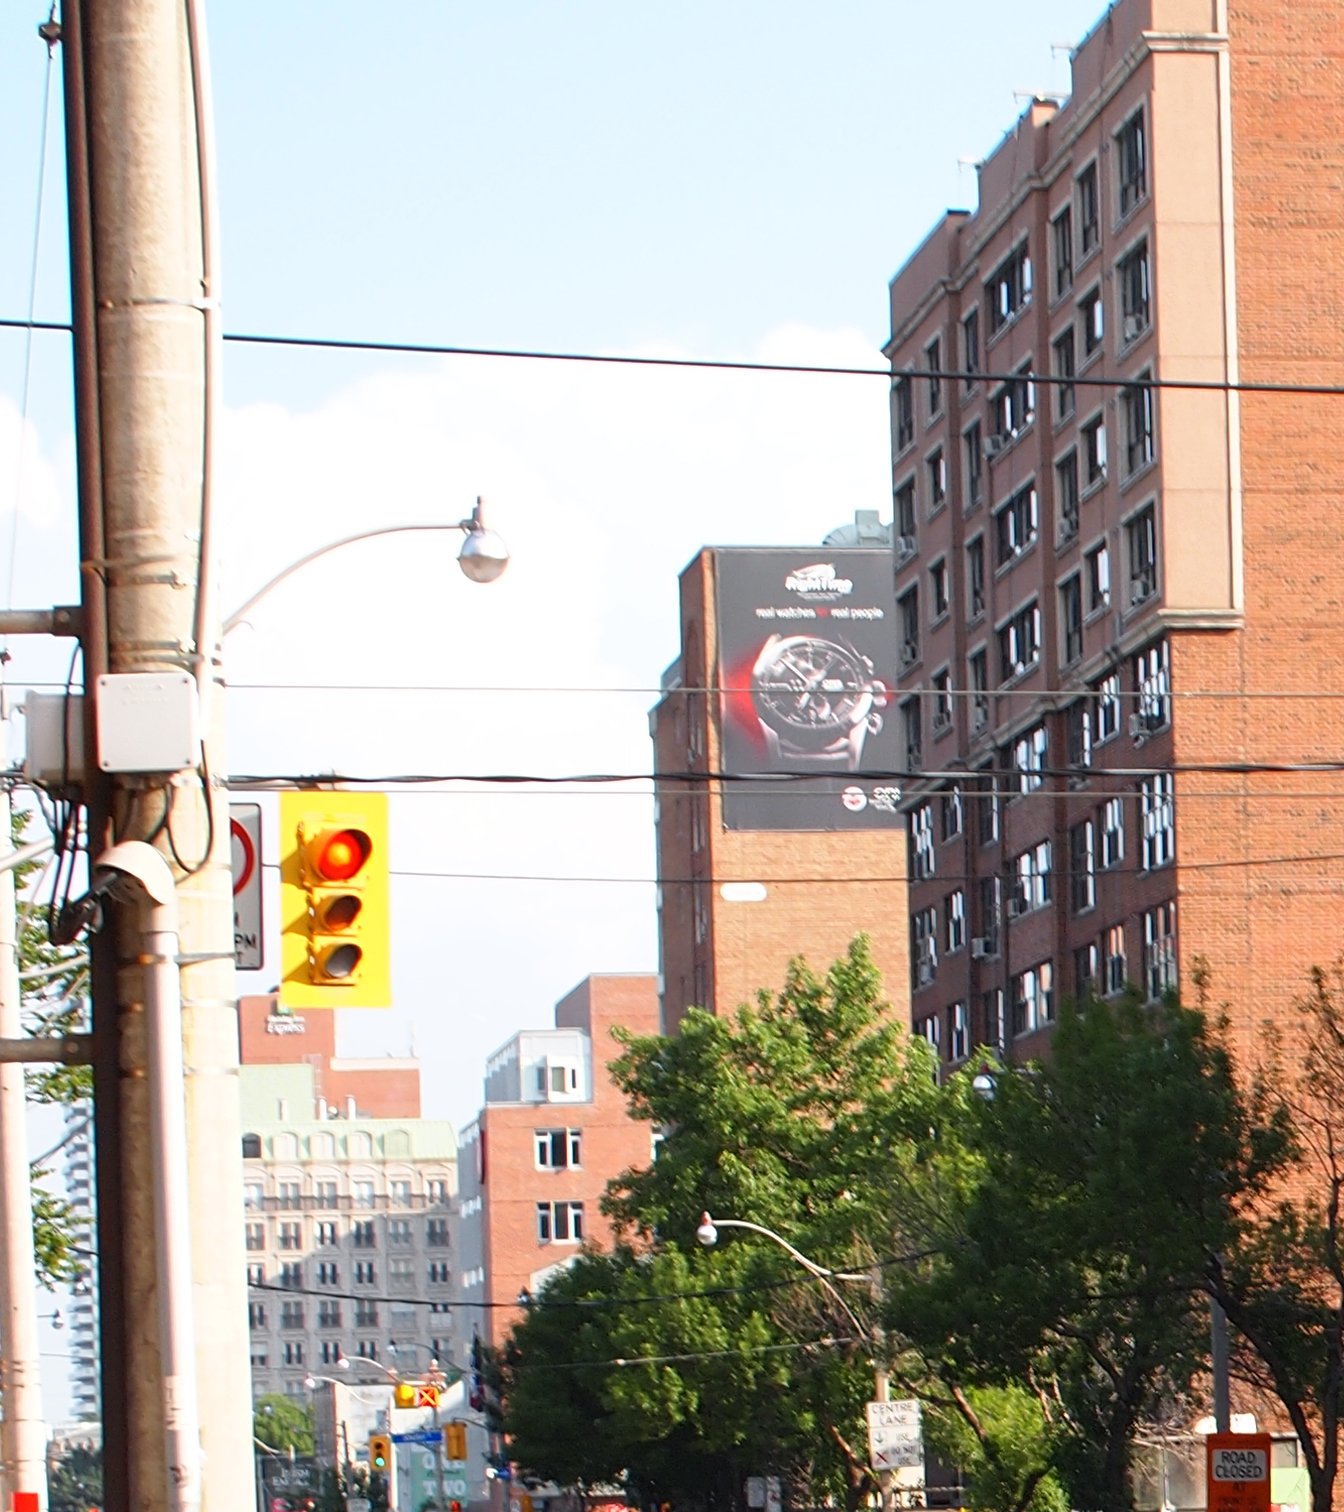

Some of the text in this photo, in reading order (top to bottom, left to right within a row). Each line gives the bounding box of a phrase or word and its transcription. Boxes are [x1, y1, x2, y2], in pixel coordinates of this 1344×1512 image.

[872, 1402, 913, 1414] CENTRE
[880, 1414, 907, 1426] LANE
[1221, 1451, 1256, 1464] ROAD
[1215, 1464, 1262, 1479] CLOSED
